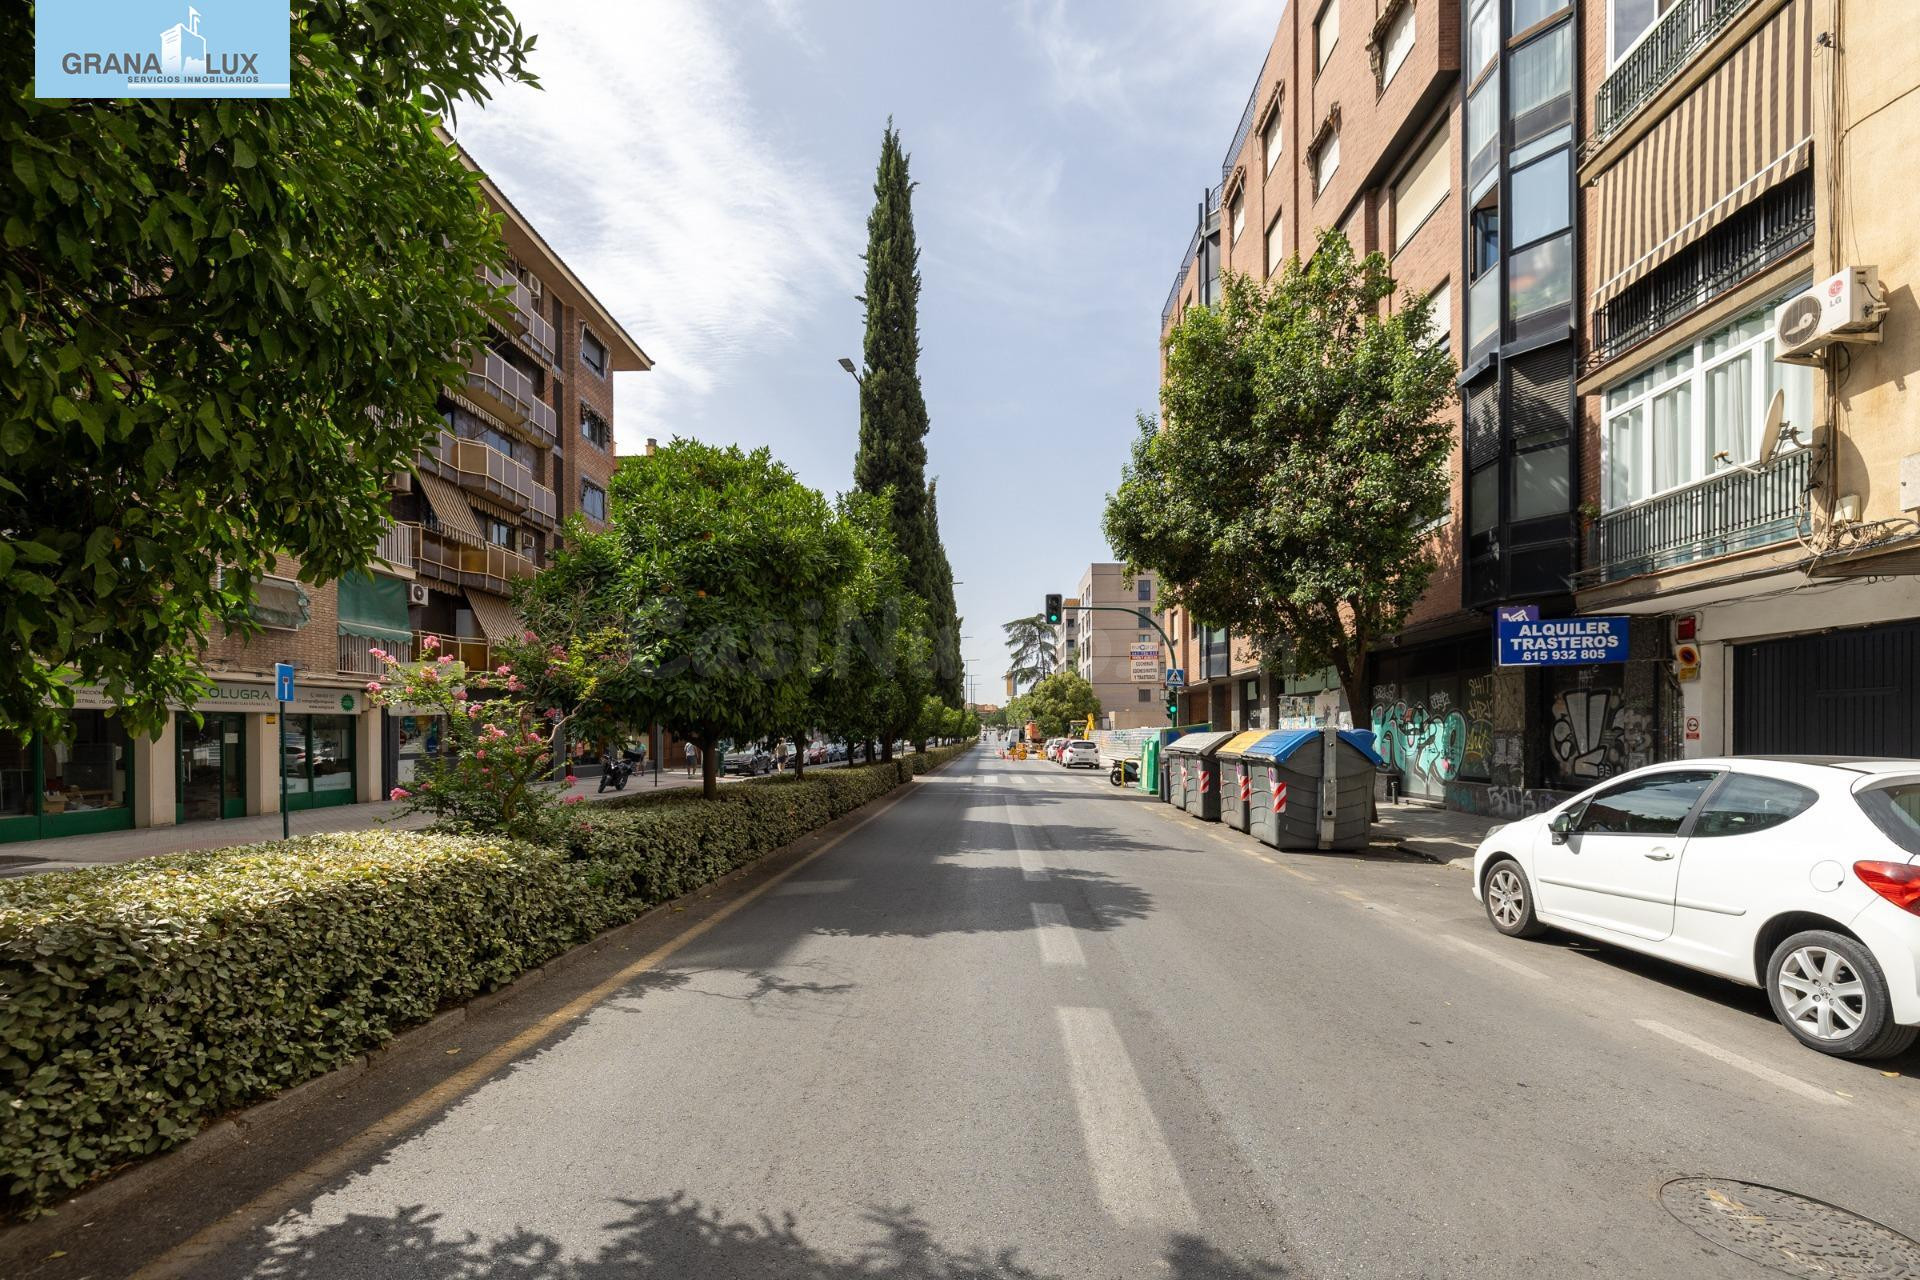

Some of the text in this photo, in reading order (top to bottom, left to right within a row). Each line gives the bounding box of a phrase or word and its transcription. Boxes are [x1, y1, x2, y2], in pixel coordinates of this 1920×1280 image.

[1829, 296, 1842, 308] LG
[1519, 622, 1611, 637] ALQUILER
[1510, 635, 1619, 650] TRASTEROS
[1522, 649, 1606, 661] 615 932 805
